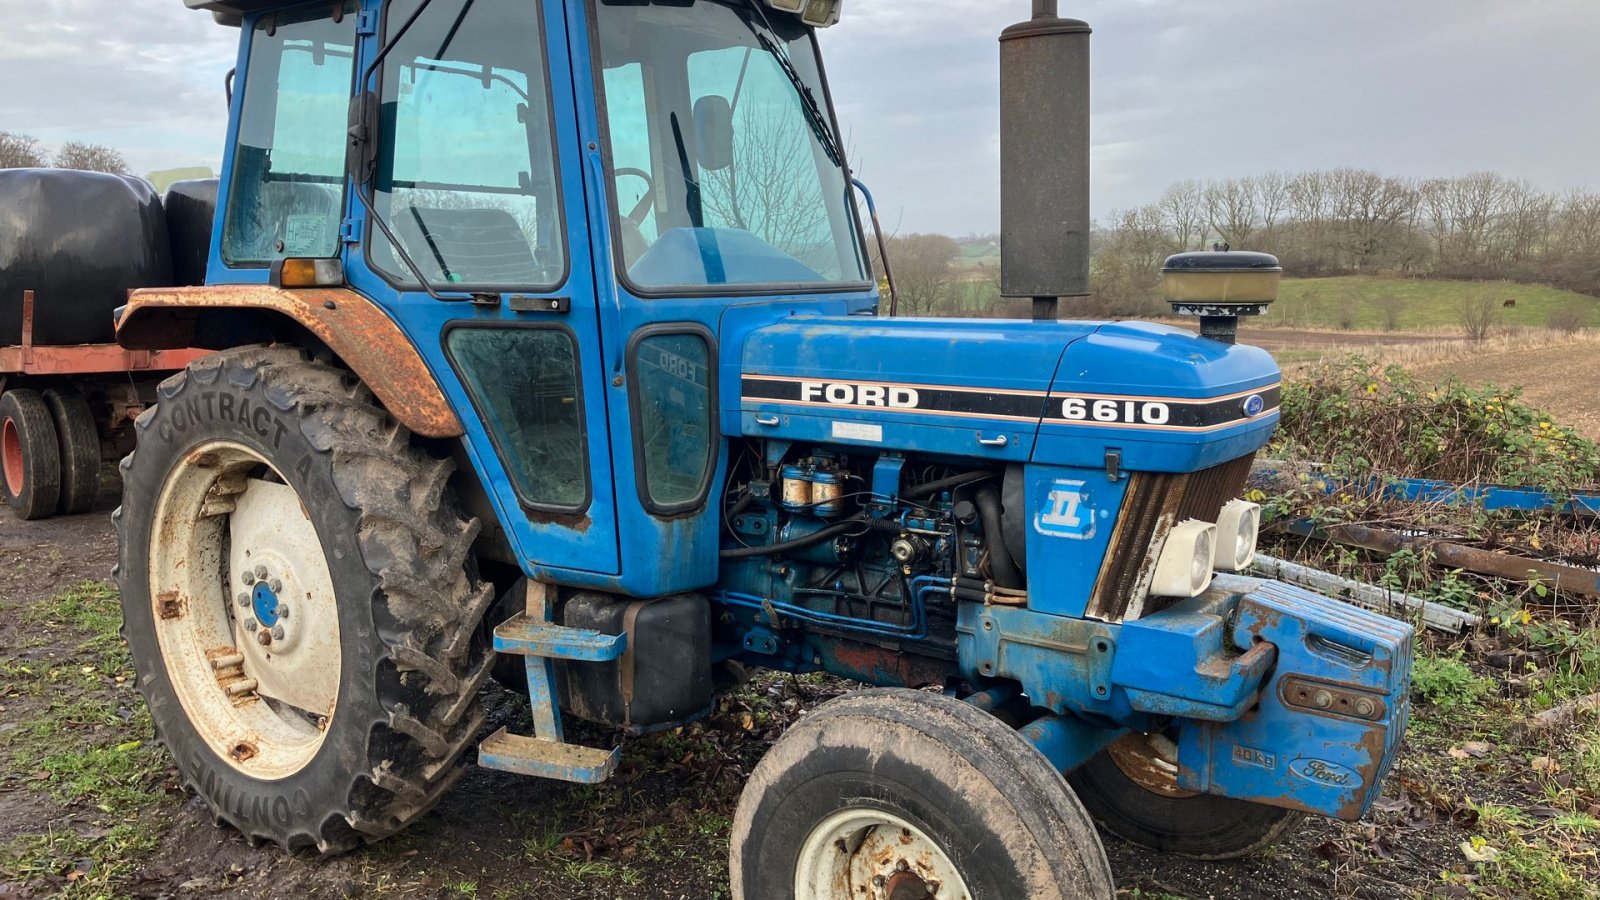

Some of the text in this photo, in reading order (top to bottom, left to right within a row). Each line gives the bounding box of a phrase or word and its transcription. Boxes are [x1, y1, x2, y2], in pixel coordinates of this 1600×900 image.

[801, 381, 919, 408] FORD
[160, 391, 289, 450] CONTRACT
[1062, 398, 1170, 425] 6610
[1234, 748, 1252, 761] 40
[1303, 760, 1350, 785] Ford
